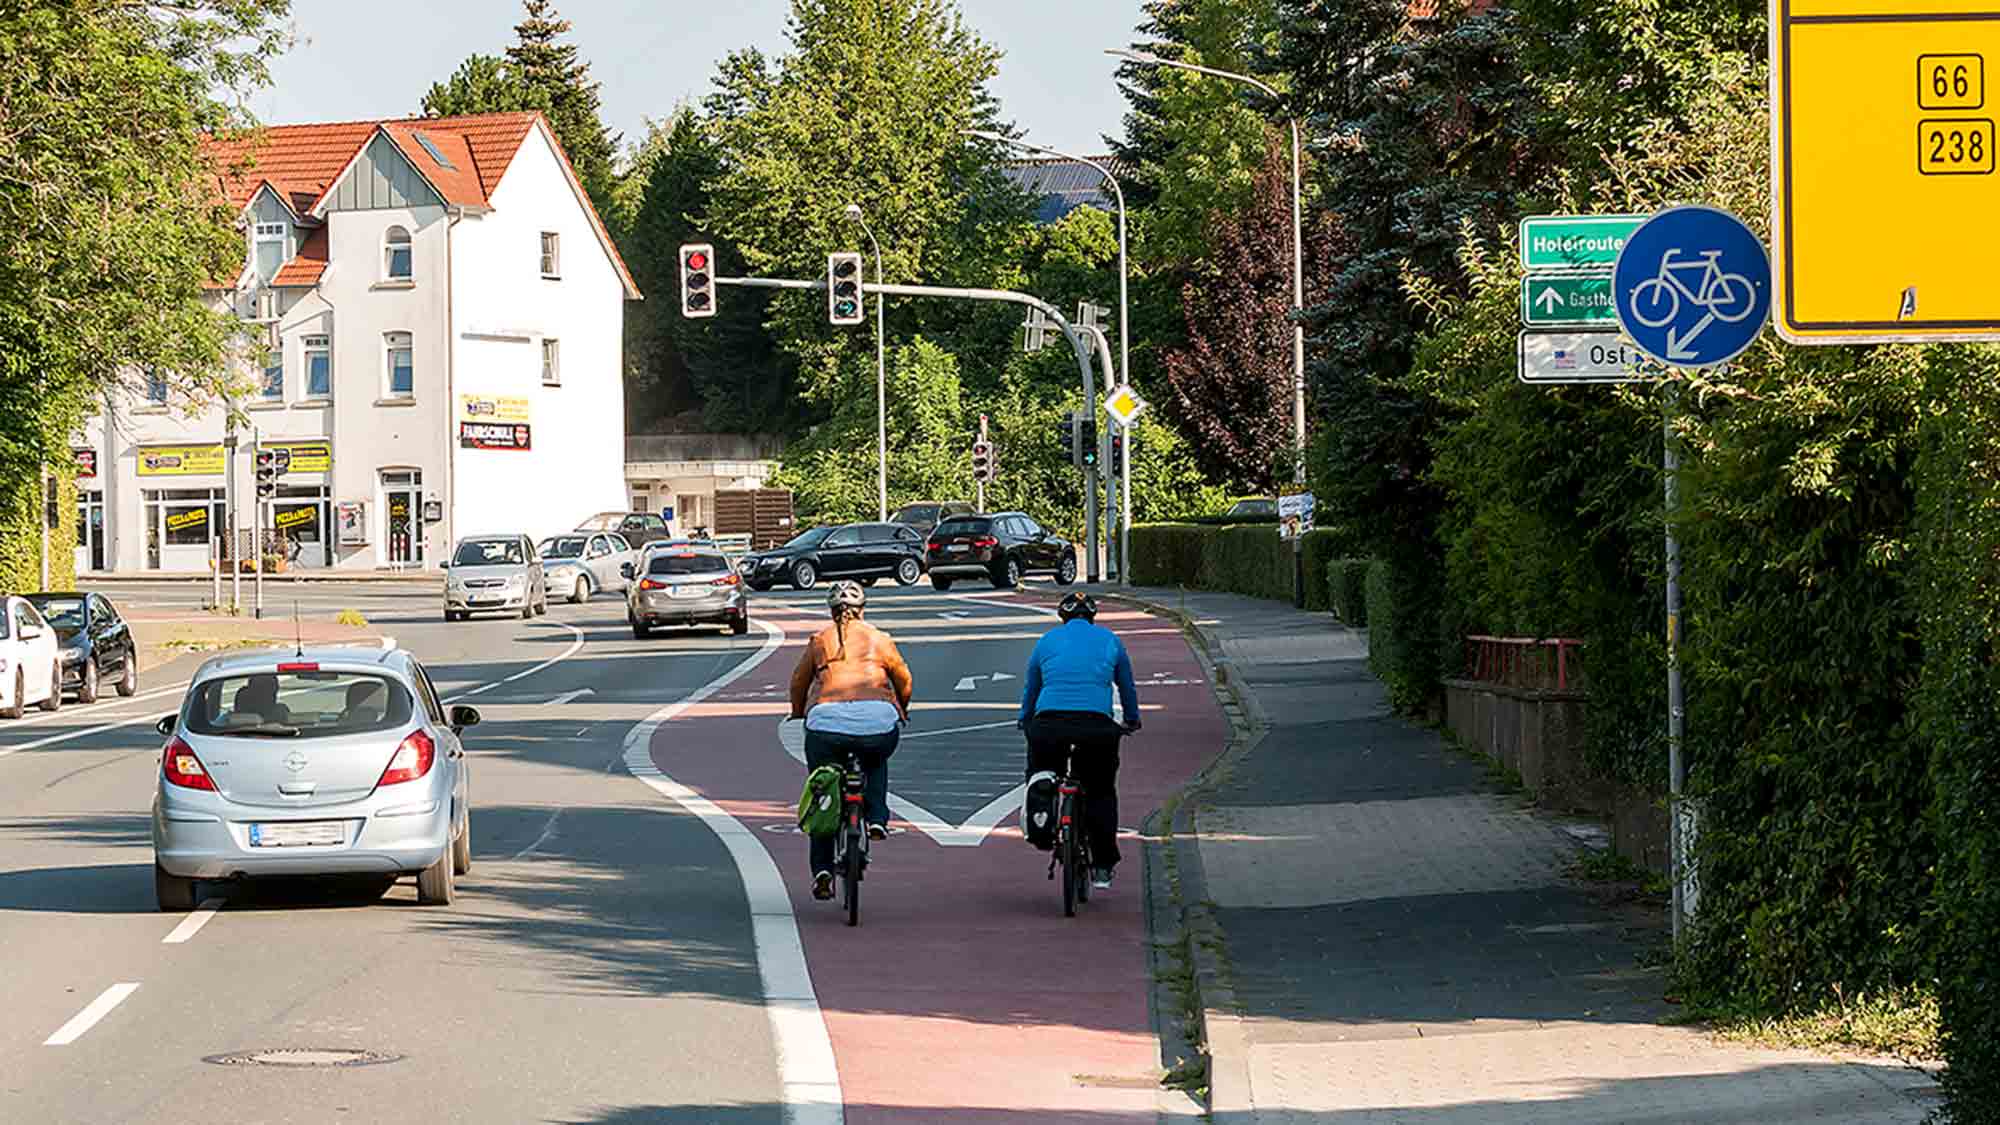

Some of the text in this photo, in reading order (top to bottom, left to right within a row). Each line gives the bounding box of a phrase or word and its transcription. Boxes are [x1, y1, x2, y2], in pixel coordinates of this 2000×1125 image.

[1932, 65, 1968, 97] 66
[1929, 130, 1984, 163] 238
[1569, 291, 1615, 307] Gastho
[1590, 345, 1626, 365] Ost
